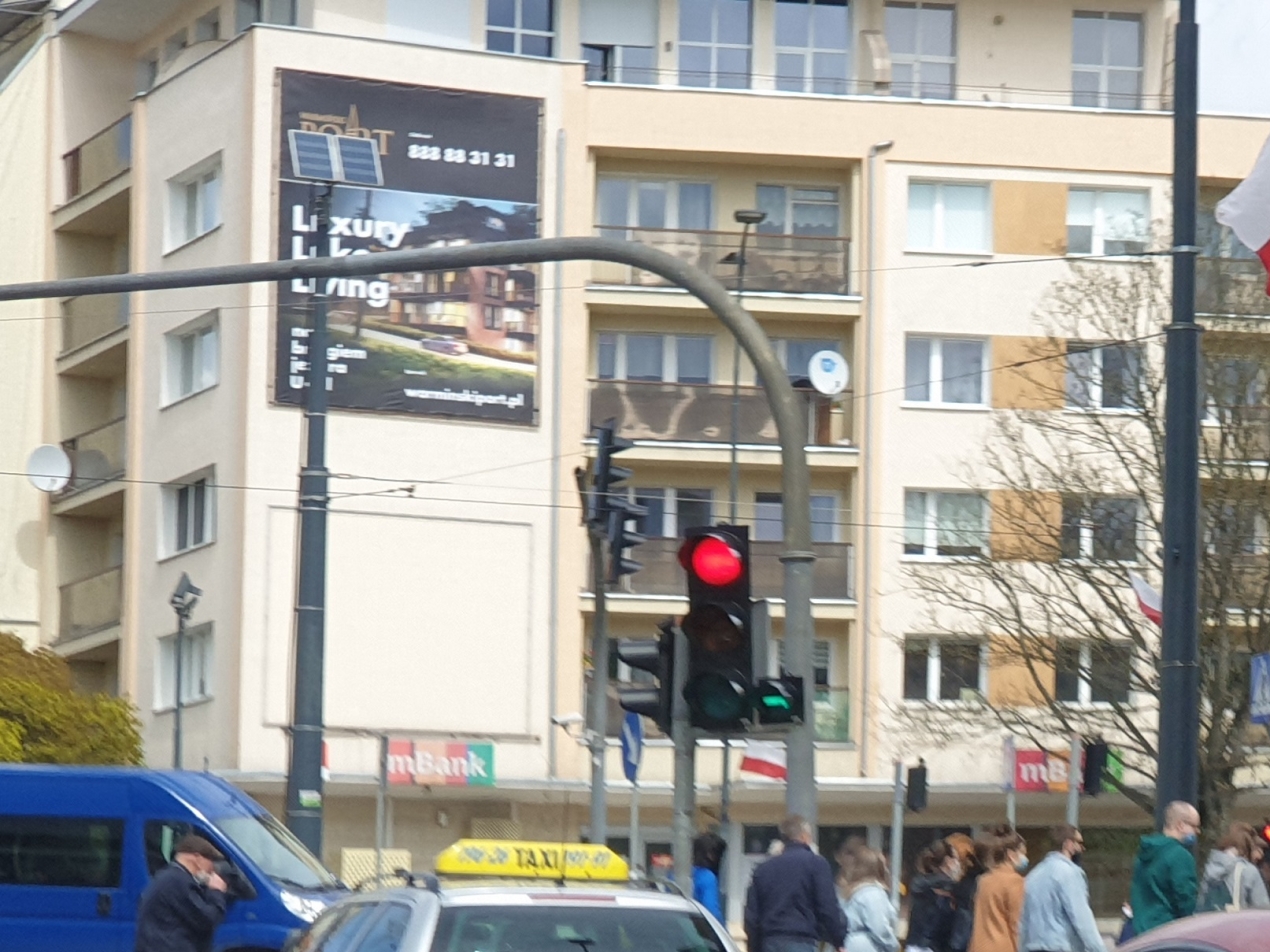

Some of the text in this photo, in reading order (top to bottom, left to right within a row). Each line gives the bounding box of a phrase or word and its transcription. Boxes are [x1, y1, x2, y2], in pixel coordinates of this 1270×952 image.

[468, 150, 490, 166] 31
[493, 152, 516, 168] 31
[388, 750, 488, 777] mBank
[514, 847, 559, 870] TAXI
